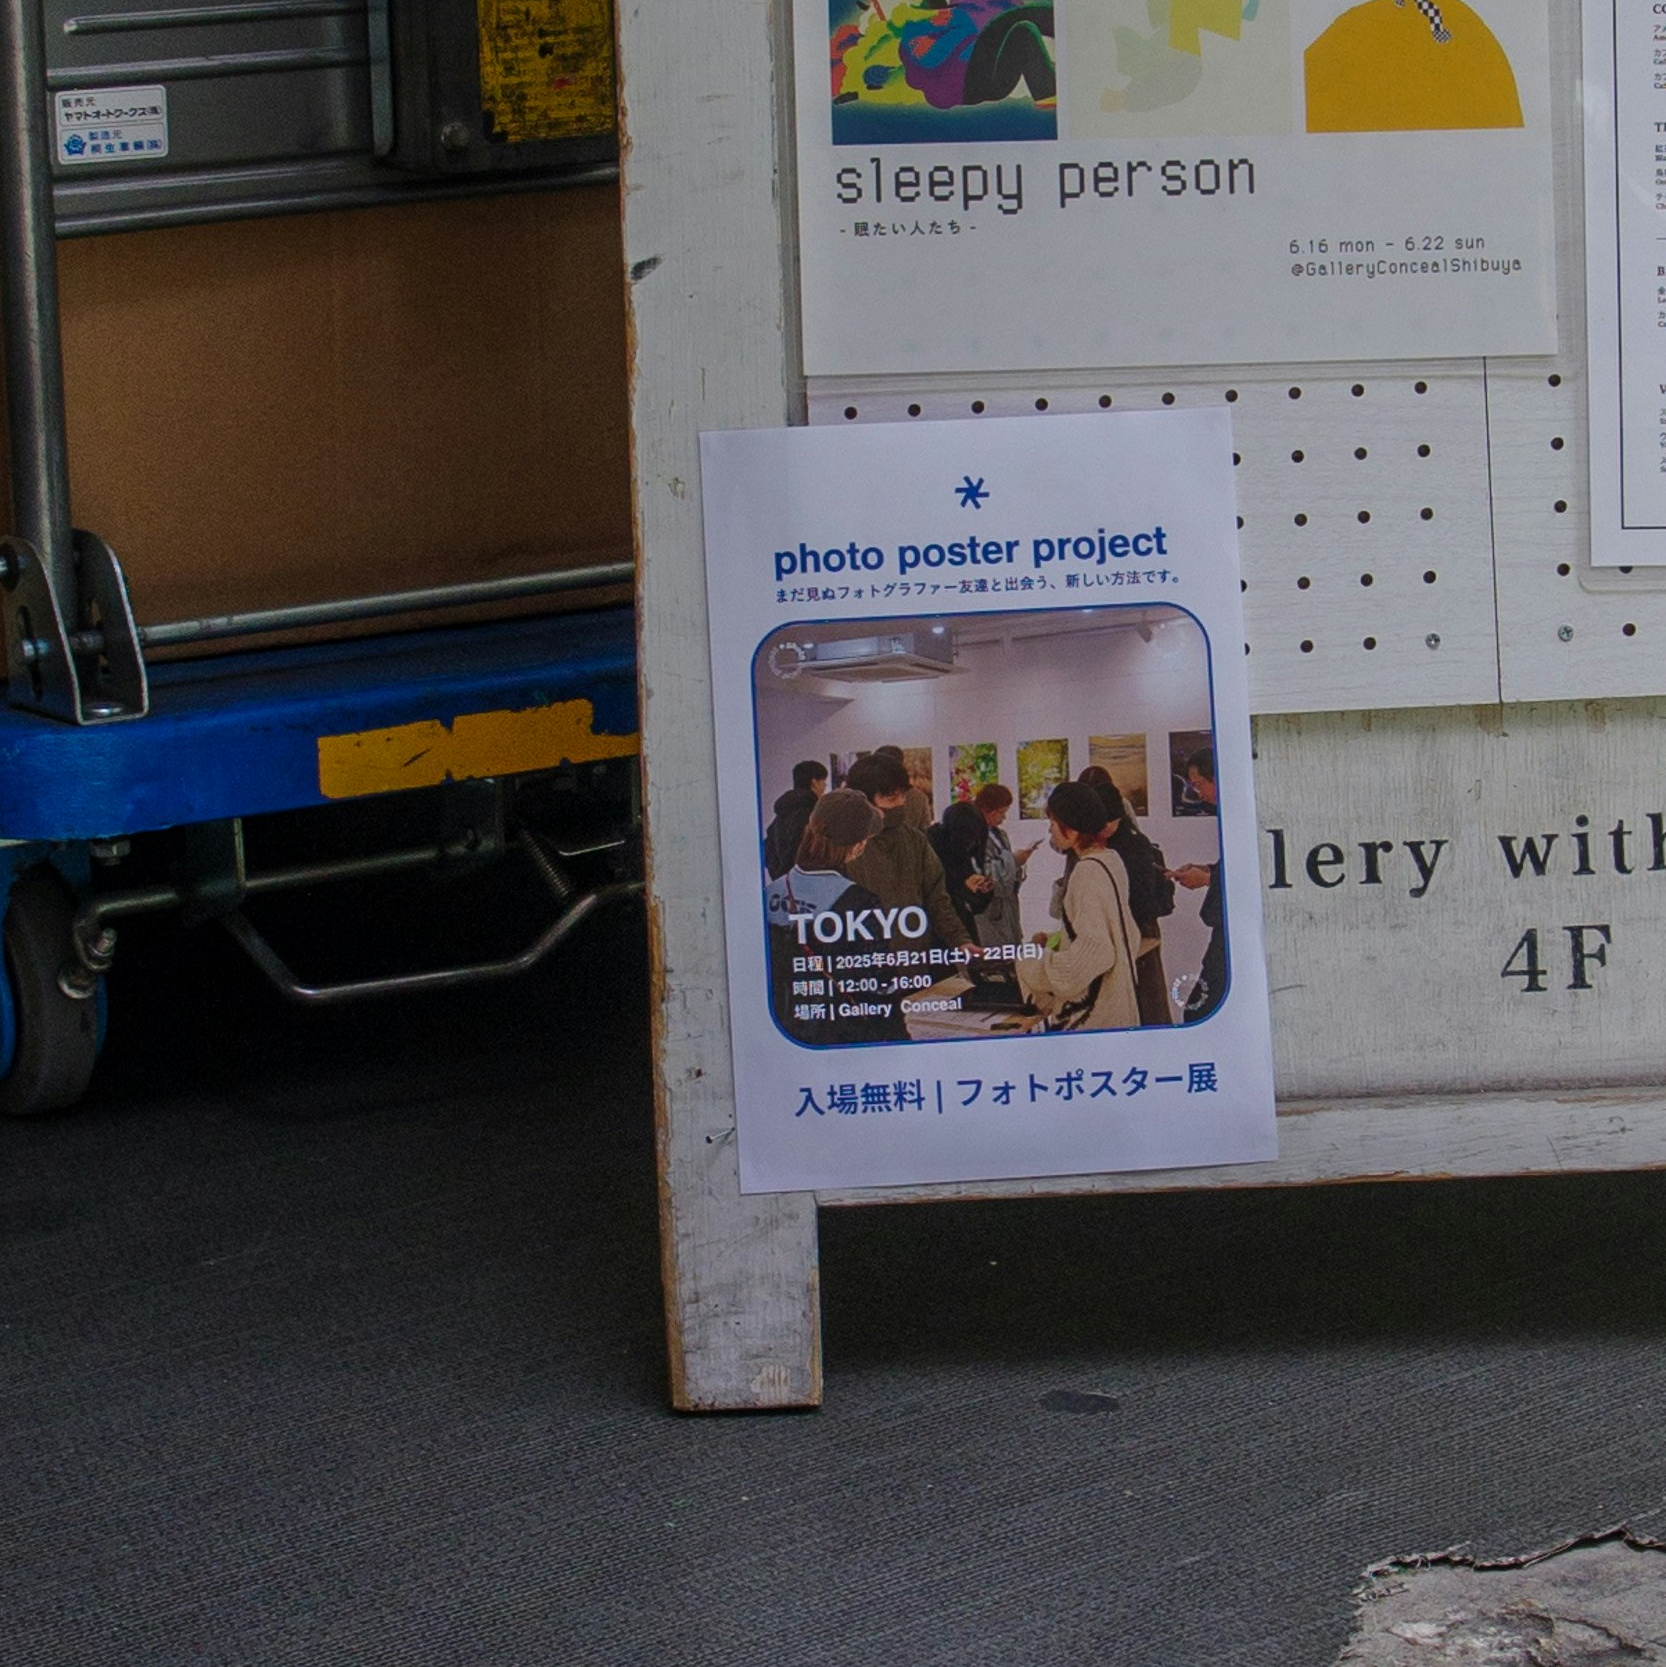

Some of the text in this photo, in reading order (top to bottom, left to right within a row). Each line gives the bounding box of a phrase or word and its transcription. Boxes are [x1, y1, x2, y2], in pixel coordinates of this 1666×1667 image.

[836, 155, 1255, 214] sleepy person
[854, 218, 961, 237] 眠たい人たち
[1289, 235, 1486, 254] 6.16 mon 6.22 sun
[1290, 257, 1523, 280] @GalleryConcealShibuya
[774, 525, 1168, 581] photo poster project
[776, 570, 1180, 603] まだ見ぬフォトグラファー友達と出会う、新しい方法です。
[1268, 829, 1449, 898] lery
[788, 905, 927, 944] TOKYO
[793, 944, 1043, 973] 日程 2025年6月21日(土) 22日(日)
[1500, 924, 1613, 993] 4F
[793, 975, 932, 996] 時間 12:00 16:00
[795, 997, 962, 1021] 場所 Gallery Conceal
[795, 1061, 1219, 1117] 入場無料 フォトポスター展
